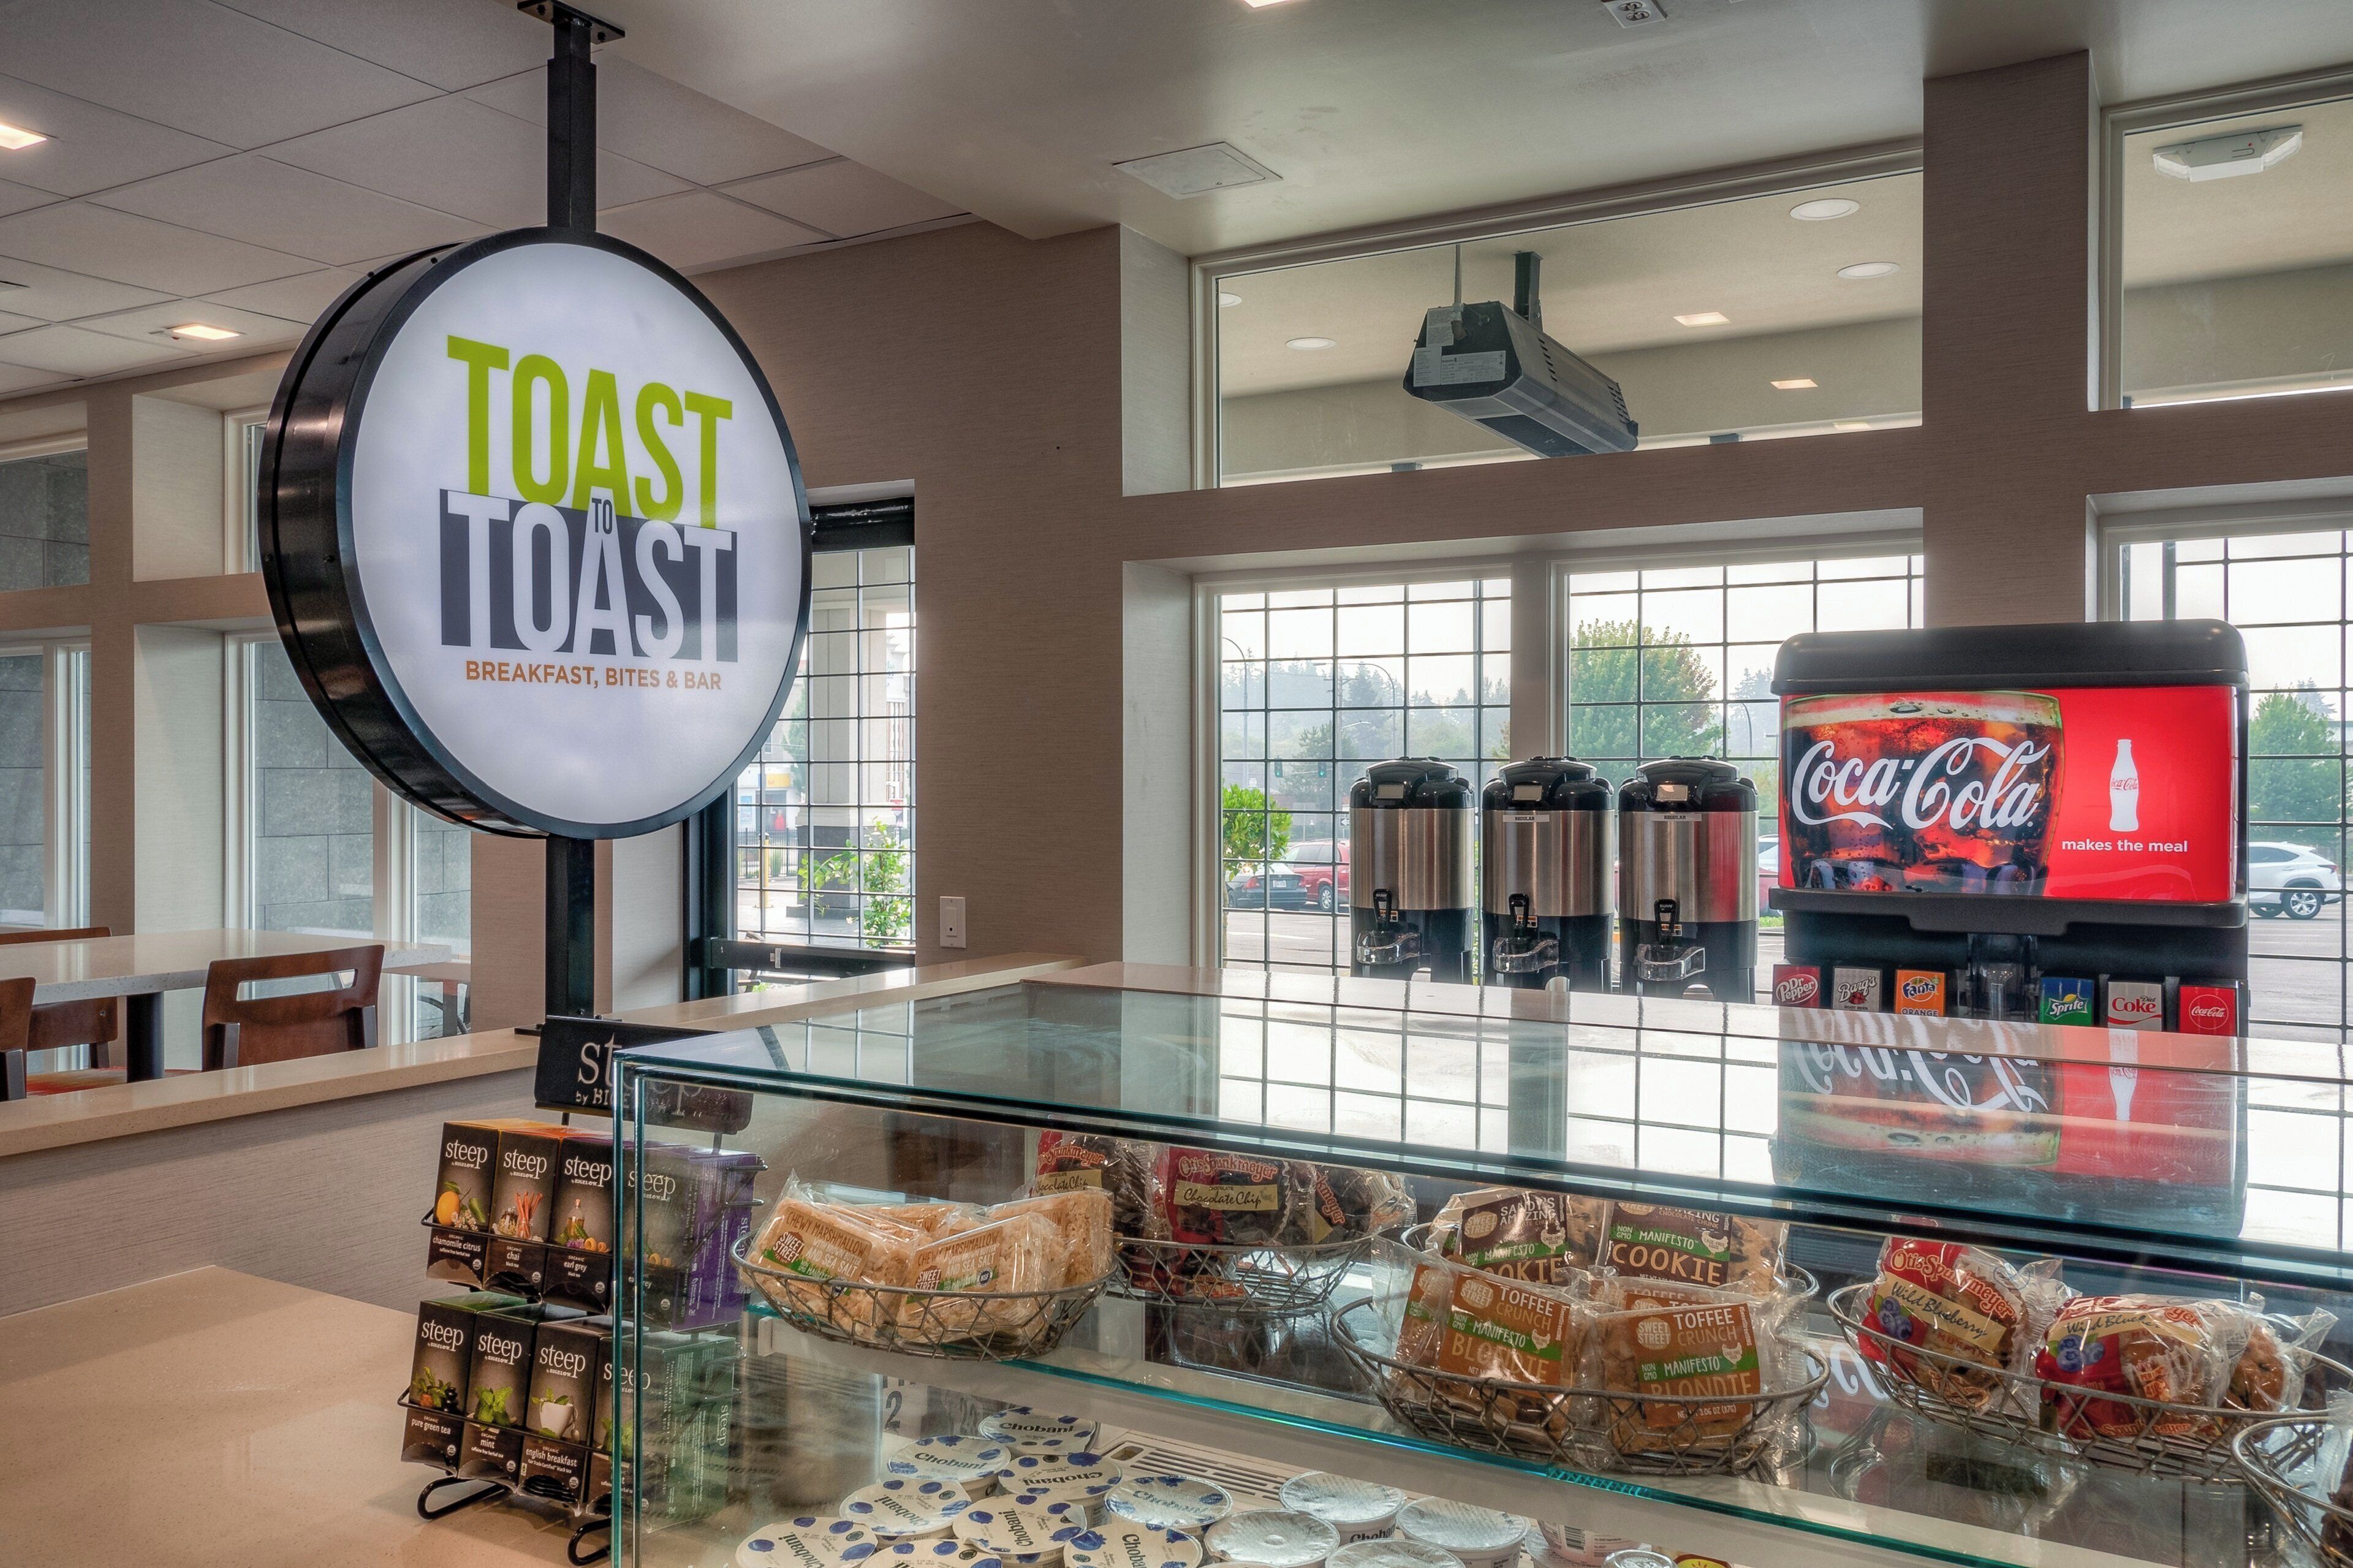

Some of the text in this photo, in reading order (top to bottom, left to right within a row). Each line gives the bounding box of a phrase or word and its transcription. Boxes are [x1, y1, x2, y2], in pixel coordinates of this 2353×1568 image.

[447, 335, 732, 529] TOAST
[591, 497, 613, 534] TO
[442, 489, 737, 662] TOAST
[466, 661, 721, 690] BREAKFAST, BITES & BAR
[1792, 737, 2050, 830] Coca-Cola
[2062, 838, 2188, 852] makes the meal
[1778, 980, 1815, 1002] Pepper
[1788, 977, 1805, 990] Dr
[1838, 976, 1877, 1003] Barq's
[1902, 981, 1936, 999] Fanta
[1902, 1008, 1938, 1017] ORANGE
[2049, 998, 2085, 1015] Sprite
[2112, 998, 2156, 1013] Coke
[445, 1140, 488, 1168] steep
[504, 1149, 547, 1180] steep
[1047, 1142, 1105, 1167] Spunkmeyer
[564, 1156, 612, 1187] steep
[1179, 1153, 1279, 1183] Otis Spunkmeyer
[628, 1170, 675, 1201] seep
[1184, 1187, 1261, 1209] Chocolate Chip
[1501, 1197, 1556, 1217] SANDY'S
[1467, 1213, 1496, 1225] SWEET
[1500, 1208, 1557, 1226] AMZING
[1659, 1210, 1694, 1222] CHOCOLATE
[1697, 1218, 1719, 1229] CHUNK
[786, 1212, 868, 1256] CHEWY MARSHMALLOW
[1464, 1223, 1496, 1235] STREET
[1617, 1225, 1633, 1234] NON
[433, 1236, 481, 1252] chamomile citrus
[780, 1231, 805, 1252] SWEET
[944, 1230, 999, 1260] MARSHMALLOW
[1639, 1230, 1694, 1250] MANIFESTO
[507, 1251, 520, 1261] chai
[773, 1241, 799, 1263] STREET
[575, 1263, 587, 1273] grey
[806, 1248, 823, 1262] AND
[822, 1256, 836, 1270] SEA
[837, 1263, 858, 1278] SALT
[945, 1252, 996, 1277] AND SEA SALT
[1612, 1243, 1722, 1286] COOKIE
[915, 1280, 939, 1291] STREET
[917, 1269, 942, 1282] SWEET
[1890, 1248, 2015, 1320] Otis Spunkmeyer
[1460, 1287, 1491, 1306] STREET
[1465, 1279, 1493, 1298] SWEET
[1500, 1286, 1556, 1317] TOFFEE
[1891, 1281, 1988, 1339] Wild Blueberry
[1452, 1320, 1466, 1331] GMO
[1453, 1312, 1468, 1323] NON
[1496, 1302, 1552, 1331] CRUNCH
[1673, 1308, 1735, 1330] TOFFEE
[422, 1320, 463, 1352] steep
[1472, 1320, 1526, 1348] MANIFESTO
[1637, 1332, 1670, 1345] STREET
[1638, 1322, 1669, 1334] SWEET
[1677, 1326, 1738, 1347] CRUNCH
[478, 1332, 521, 1365] steep
[539, 1345, 586, 1378] steep
[1468, 1366, 1480, 1374] NET
[1641, 1363, 1657, 1372] NON
[1664, 1355, 1721, 1377] MANIFESTO
[1643, 1371, 1658, 1381] GMO
[1699, 1404, 1737, 1417] 3.06 OZ (87G)
[424, 1422, 440, 1431] green
[716, 1404, 730, 1446] steep
[999, 1422, 1075, 1433] Chobani
[480, 1439, 494, 1449] mint
[526, 1449, 577, 1467] english breakfast
[914, 1452, 989, 1470] Chobani
[1021, 1472, 1103, 1486] Chobani
[873, 1494, 930, 1527] Chobani
[998, 1508, 1034, 1547] Chobani
